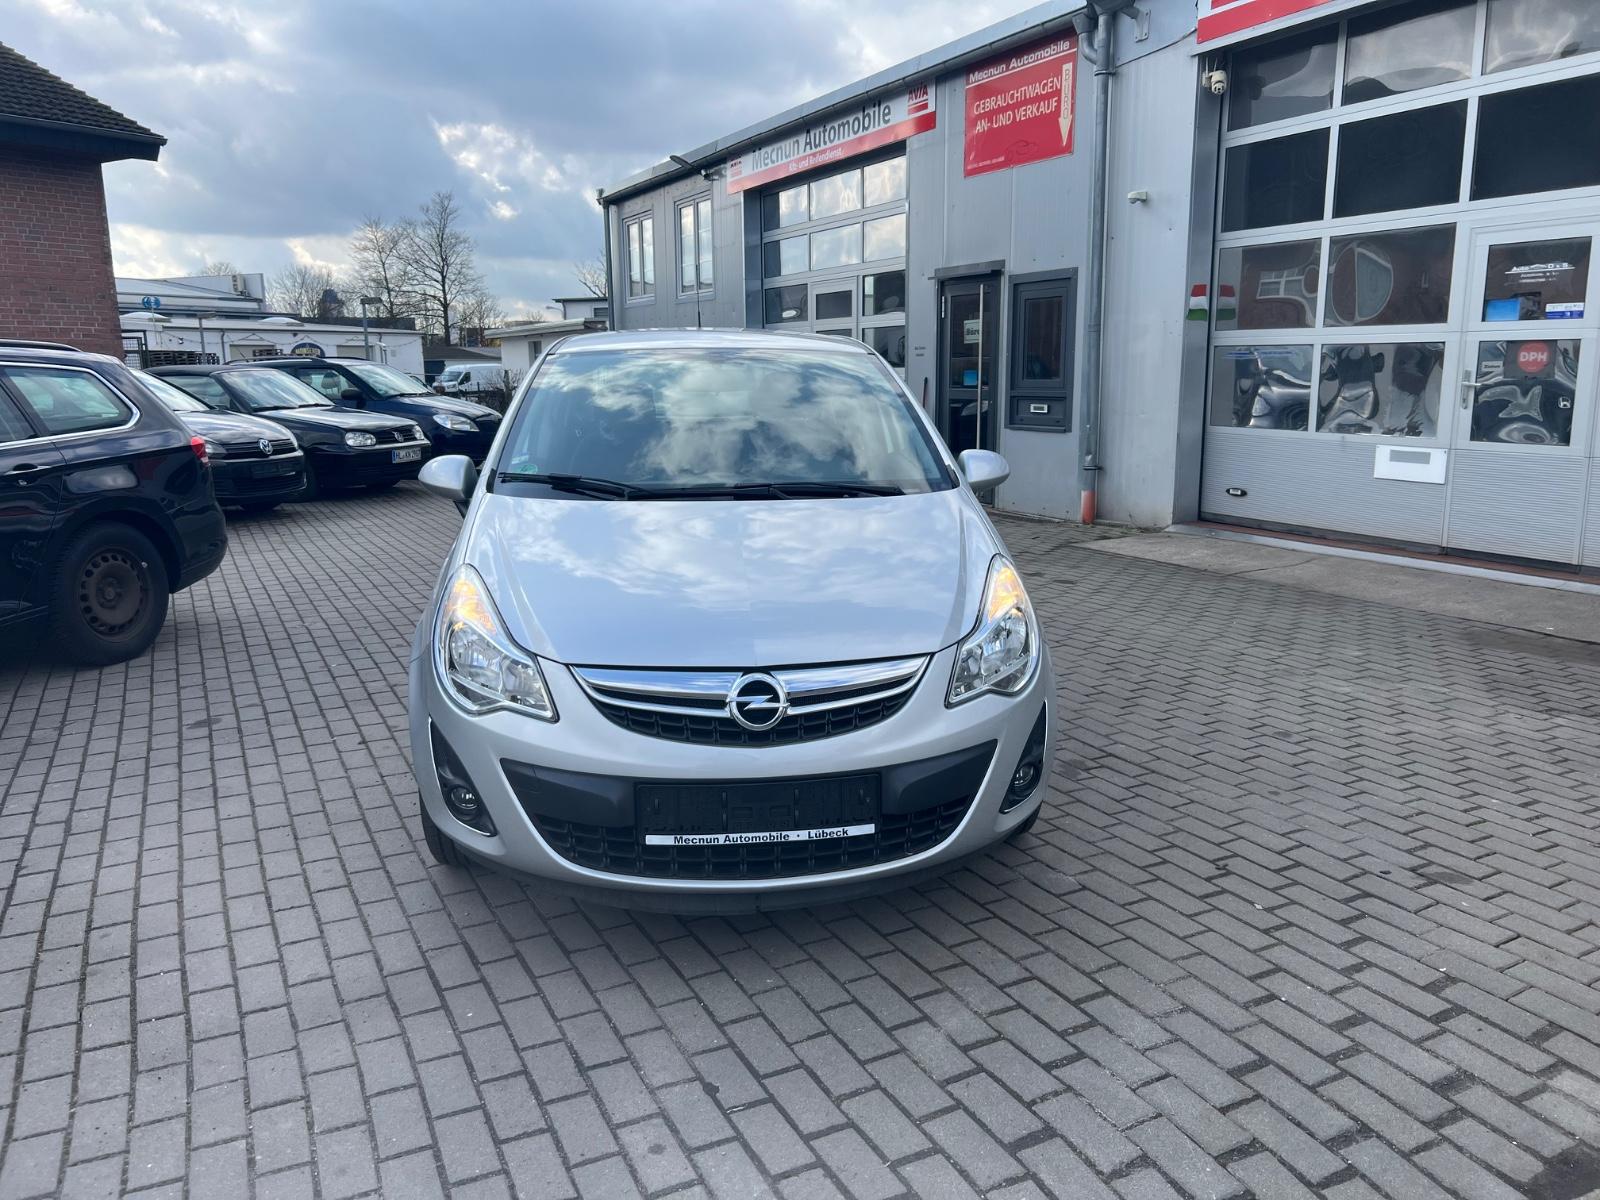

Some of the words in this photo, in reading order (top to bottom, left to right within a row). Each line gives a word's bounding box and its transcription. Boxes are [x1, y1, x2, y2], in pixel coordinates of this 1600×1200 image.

[969, 65, 1006, 83] Mecnun
[1009, 41, 1070, 70] Automobile
[908, 82, 928, 102] AVIA
[973, 75, 1061, 115] GEBRAUCHTWAGEN
[975, 118, 991, 134] AN-
[993, 111, 1013, 128] UND
[1015, 97, 1058, 122] VERKAUF
[752, 137, 800, 172] Mecnun
[803, 99, 891, 155] Automobile
[1520, 352, 1548, 362] DPH
[673, 835, 720, 845] Mecnun
[723, 831, 790, 844] Automobile
[807, 827, 850, 839] Lübeck
